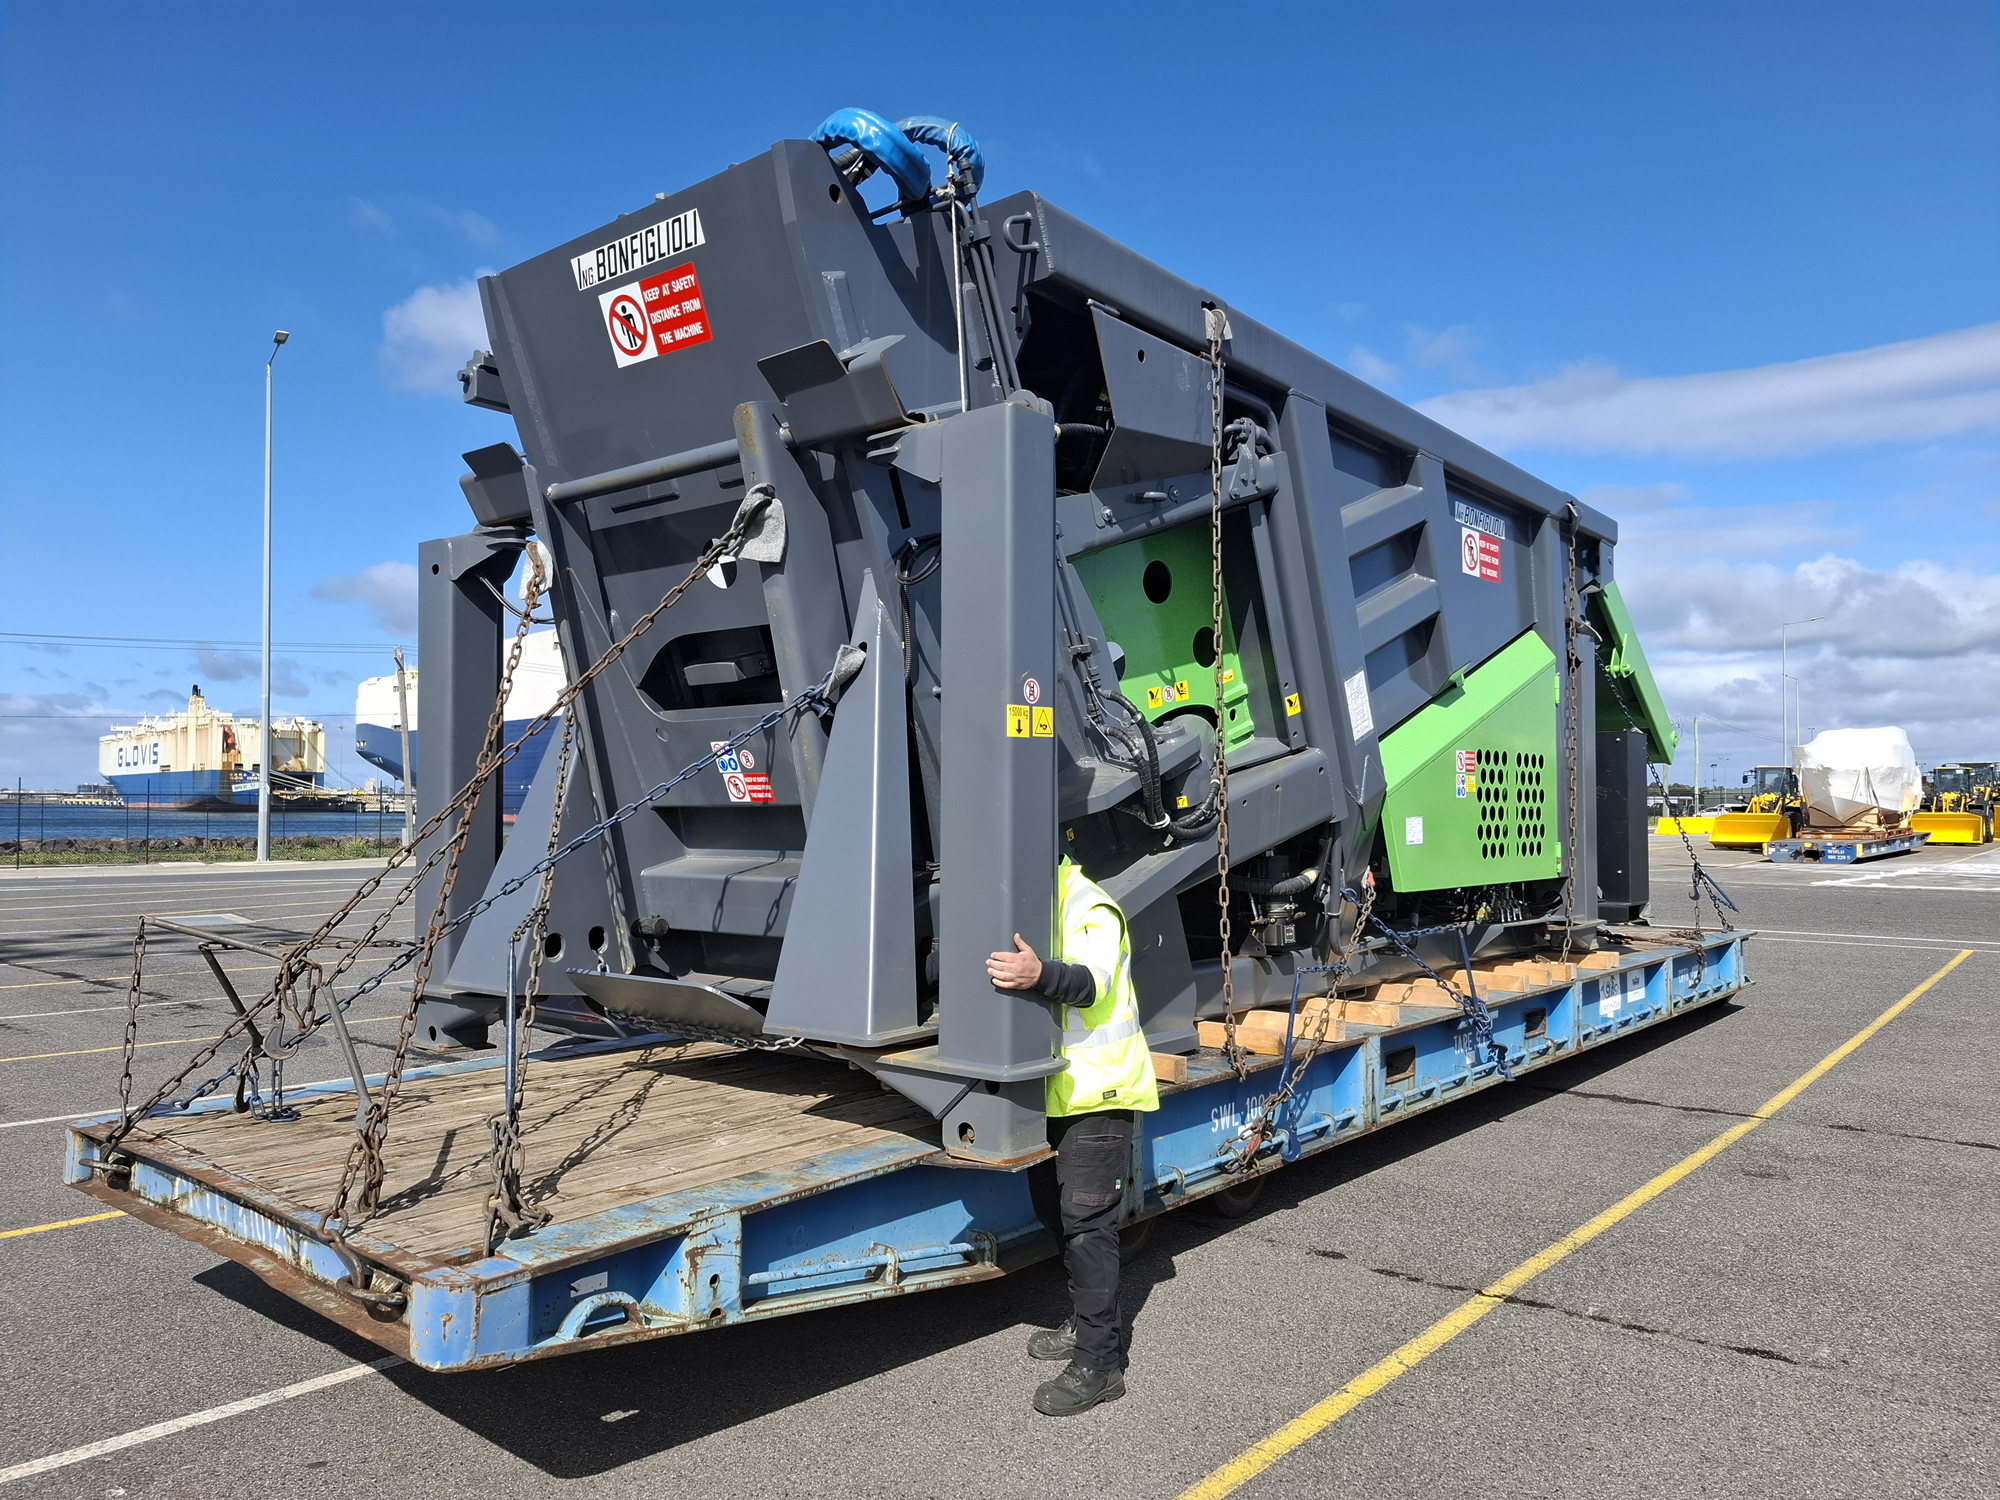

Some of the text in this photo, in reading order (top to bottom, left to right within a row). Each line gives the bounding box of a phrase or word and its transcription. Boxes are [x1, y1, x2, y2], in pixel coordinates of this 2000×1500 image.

[596, 209, 698, 283] BONFIGLIOLI
[643, 273, 696, 303] KEEP AT SAFETY
[650, 297, 702, 325] DISTANCE FROM
[659, 321, 704, 346] THE MACHINE
[1464, 506, 1506, 538] BONFIGLIOLI
[117, 742, 159, 768] GLOVIS
[1453, 1031, 1473, 1056] TARE
[1211, 1101, 1239, 1133] SWL
